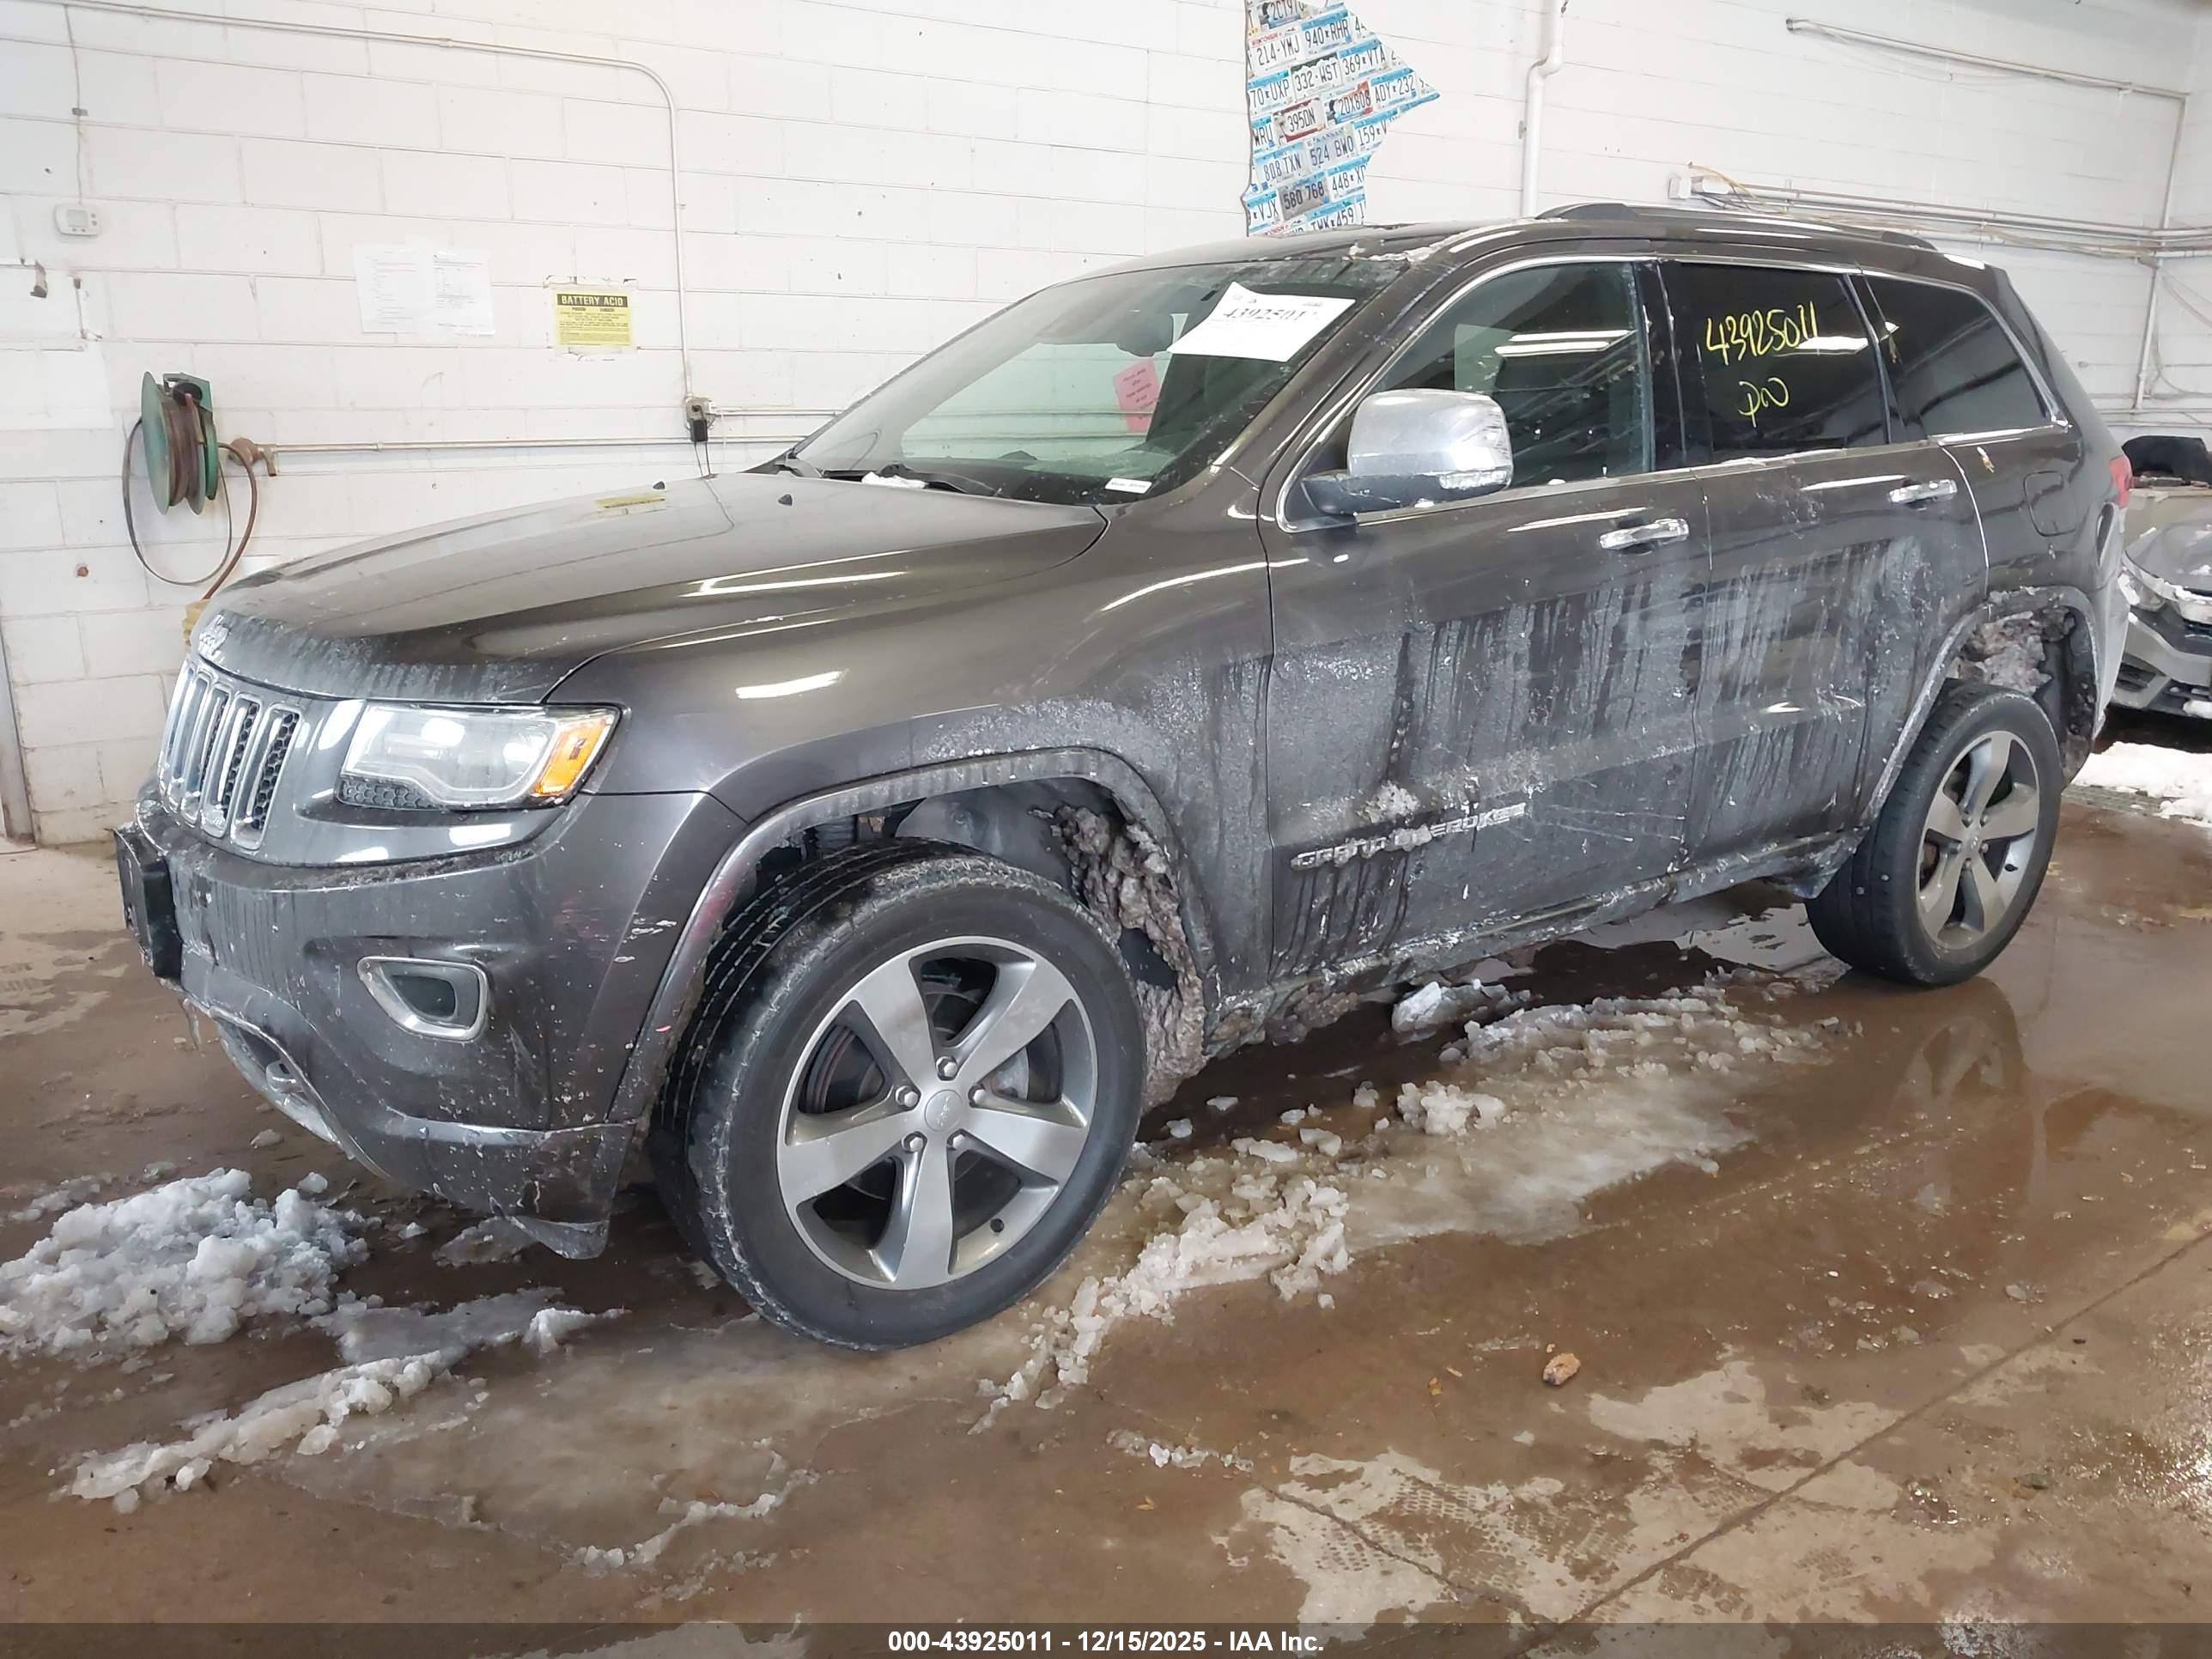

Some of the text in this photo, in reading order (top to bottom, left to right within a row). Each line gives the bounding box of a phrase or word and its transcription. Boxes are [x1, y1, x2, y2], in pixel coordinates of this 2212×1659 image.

[1305, 27, 1324, 48] 940
[1343, 53, 1361, 76] 369
[1397, 75, 1416, 96] 232
[1263, 153, 1302, 182] 808 TXN
[1304, 180, 1325, 201] 768
[1332, 172, 1350, 192] 448
[561, 295, 623, 307] BATTERY ACID
[1705, 301, 1819, 367] 43925011
